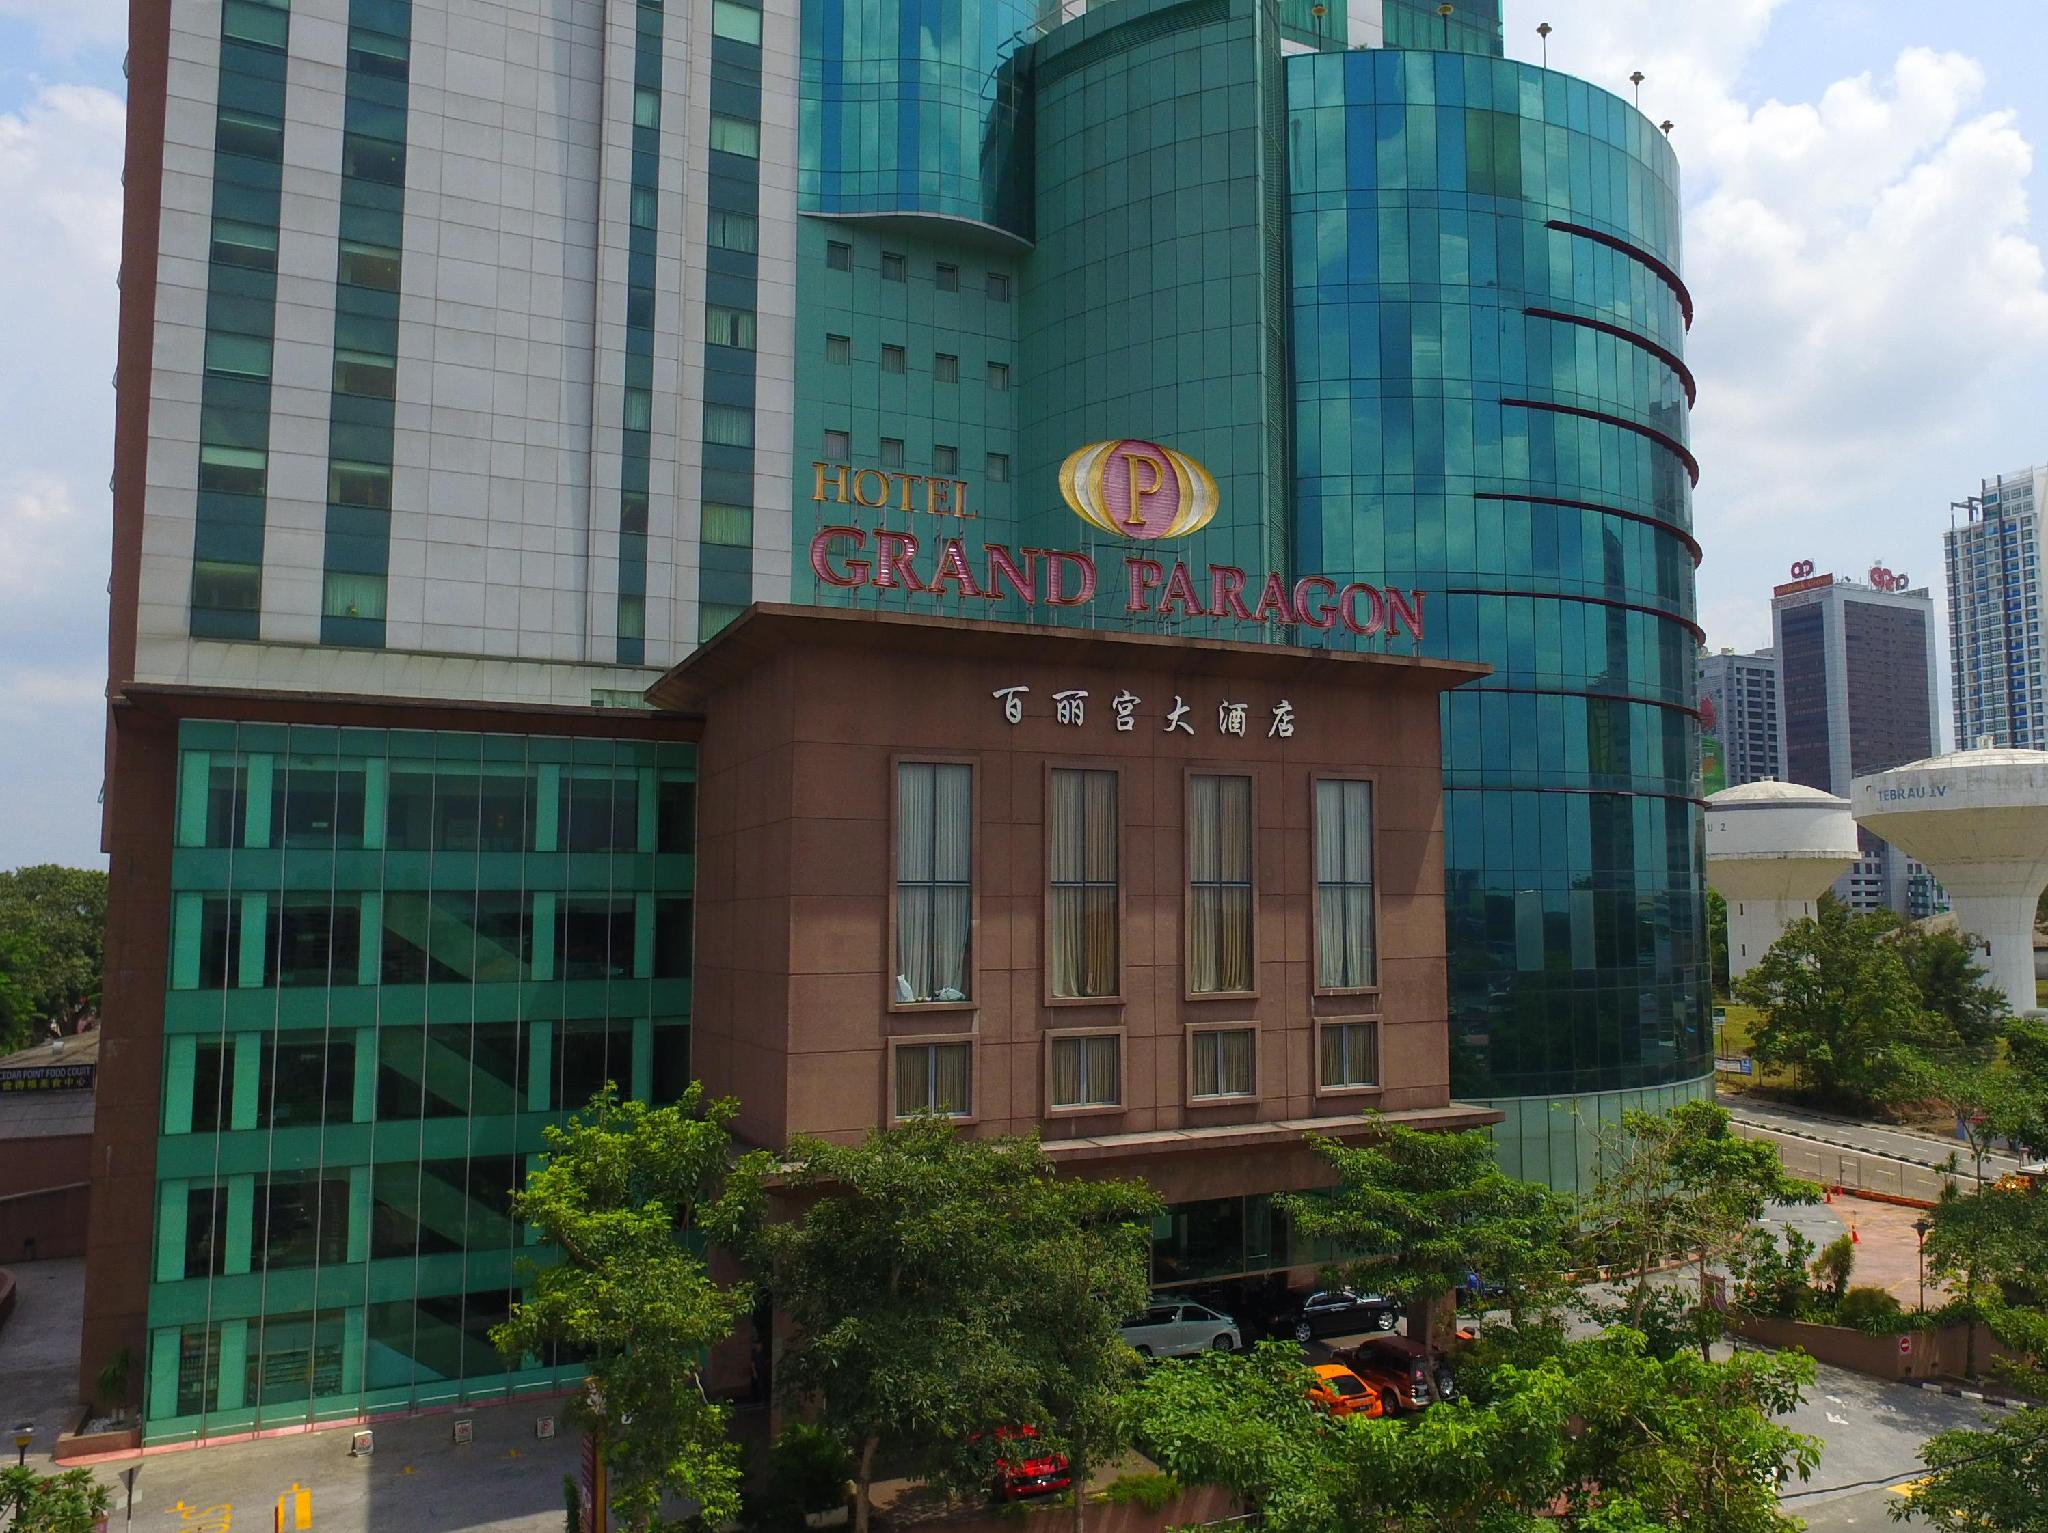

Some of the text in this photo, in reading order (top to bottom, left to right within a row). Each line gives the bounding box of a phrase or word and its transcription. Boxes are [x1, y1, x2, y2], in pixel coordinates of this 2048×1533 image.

[811, 461, 978, 519] HOTEL
[1120, 454, 1164, 525] P
[811, 525, 1427, 641] GRAND PARAGON
[991, 685, 1297, 738] 百丽宫大酒店
[1878, 786, 1925, 801] TEBRAU
[1720, 822, 1727, 832] 2
